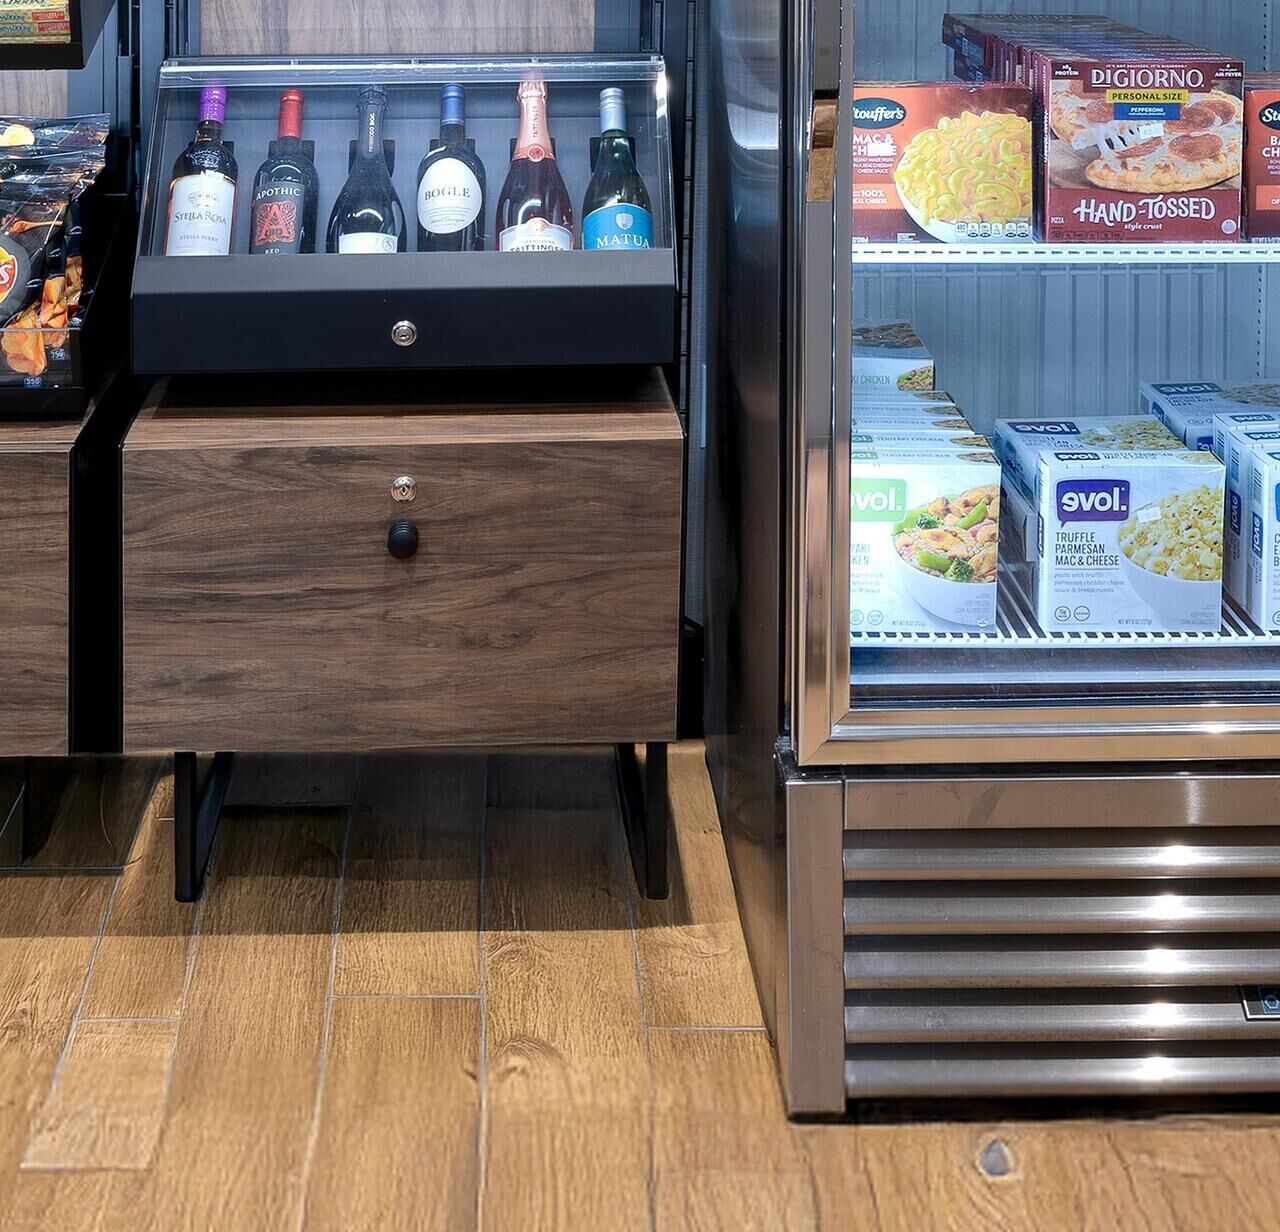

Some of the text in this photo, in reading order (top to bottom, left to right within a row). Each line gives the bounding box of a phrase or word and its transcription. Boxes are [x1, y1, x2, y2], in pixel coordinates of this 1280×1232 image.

[1111, 92, 1182, 101] PERSONAL SIZE
[255, 187, 301, 201] APOTHIC
[424, 186, 471, 201] BOGLE
[596, 234, 650, 249] MATUA
[1055, 532, 1095, 543] TRUFFLE
[1055, 543, 1105, 554] PARMESAN
[1055, 554, 1120, 566] MAC CHEESE
